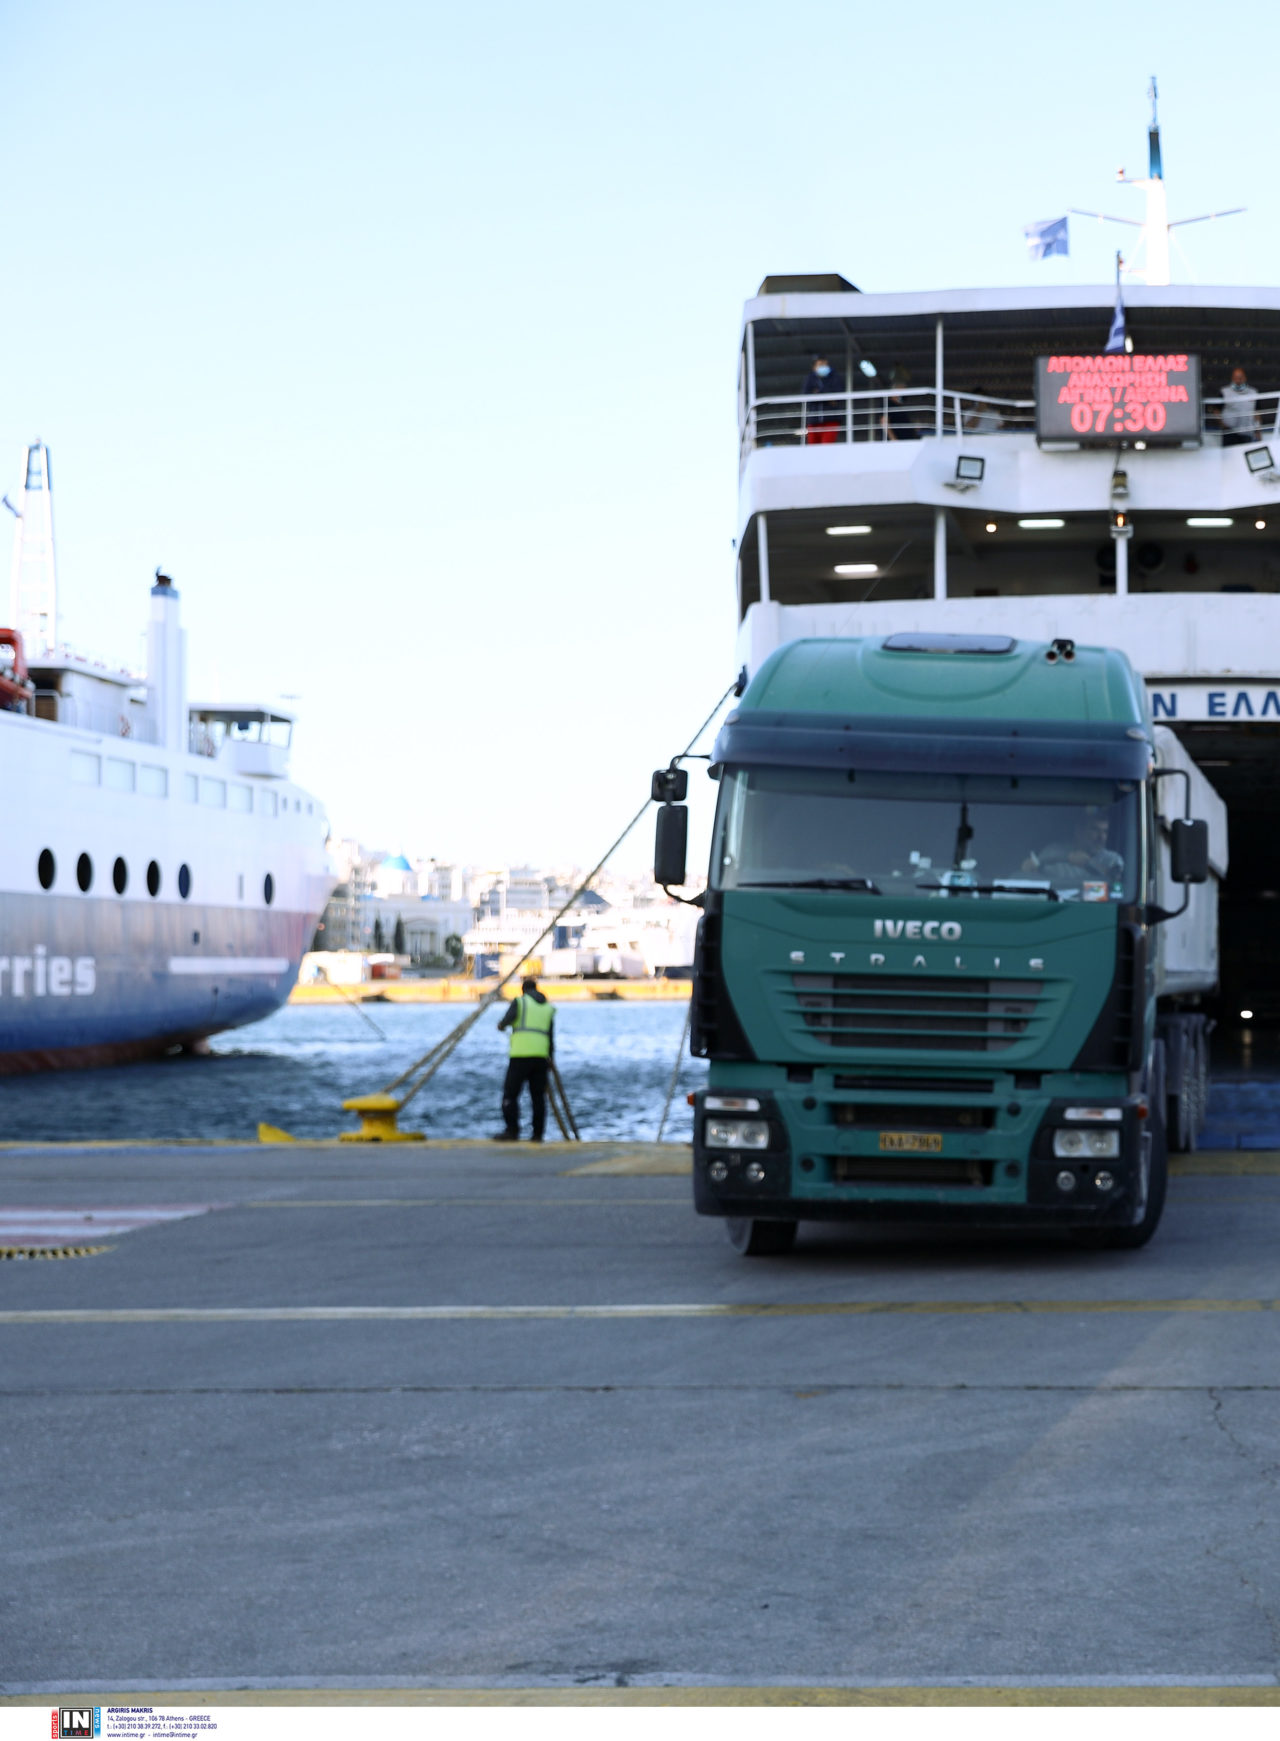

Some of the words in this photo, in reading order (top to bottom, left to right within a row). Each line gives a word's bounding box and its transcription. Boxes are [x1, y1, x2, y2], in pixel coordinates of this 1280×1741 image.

[1047, 355, 1131, 373] ΑΠΟΛΛΩΝ
[1132, 354, 1188, 372] ΕΛΛΑΣ
[1070, 402, 1167, 432] 07:30
[873, 918, 963, 941] IVECO
[789, 950, 1045, 971] STRALIS
